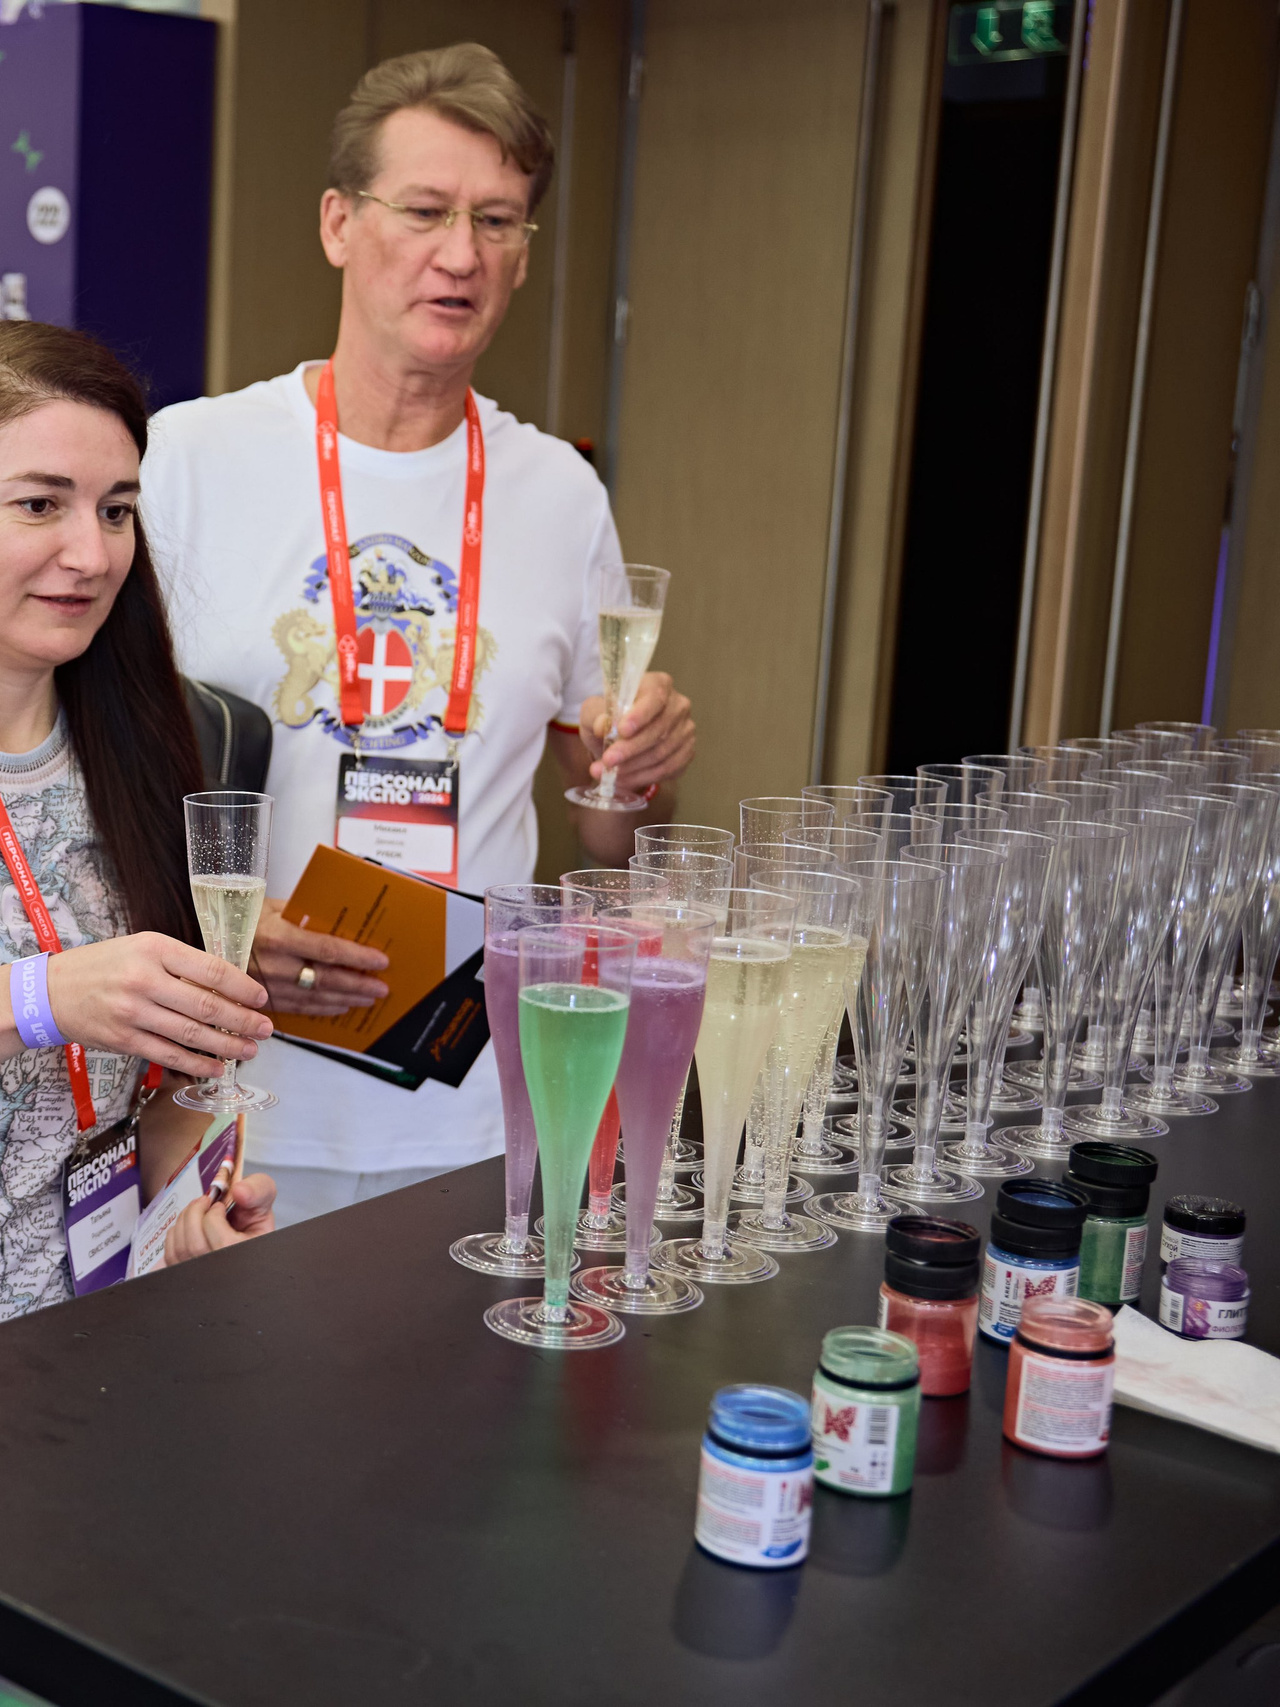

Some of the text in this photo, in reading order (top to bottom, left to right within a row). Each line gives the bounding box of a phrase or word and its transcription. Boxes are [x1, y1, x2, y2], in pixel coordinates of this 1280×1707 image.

[344, 770, 452, 793] ПЕРСОНАЛ
[344, 785, 412, 805] ЭКСПО
[3, 832, 34, 896] ПЕРСОНАЛ
[33, 907, 50, 937] ЭКСПО
[67, 1135, 136, 1192] ПЕРСОНАЛ
[68, 1167, 112, 1207] ЭКСПО
